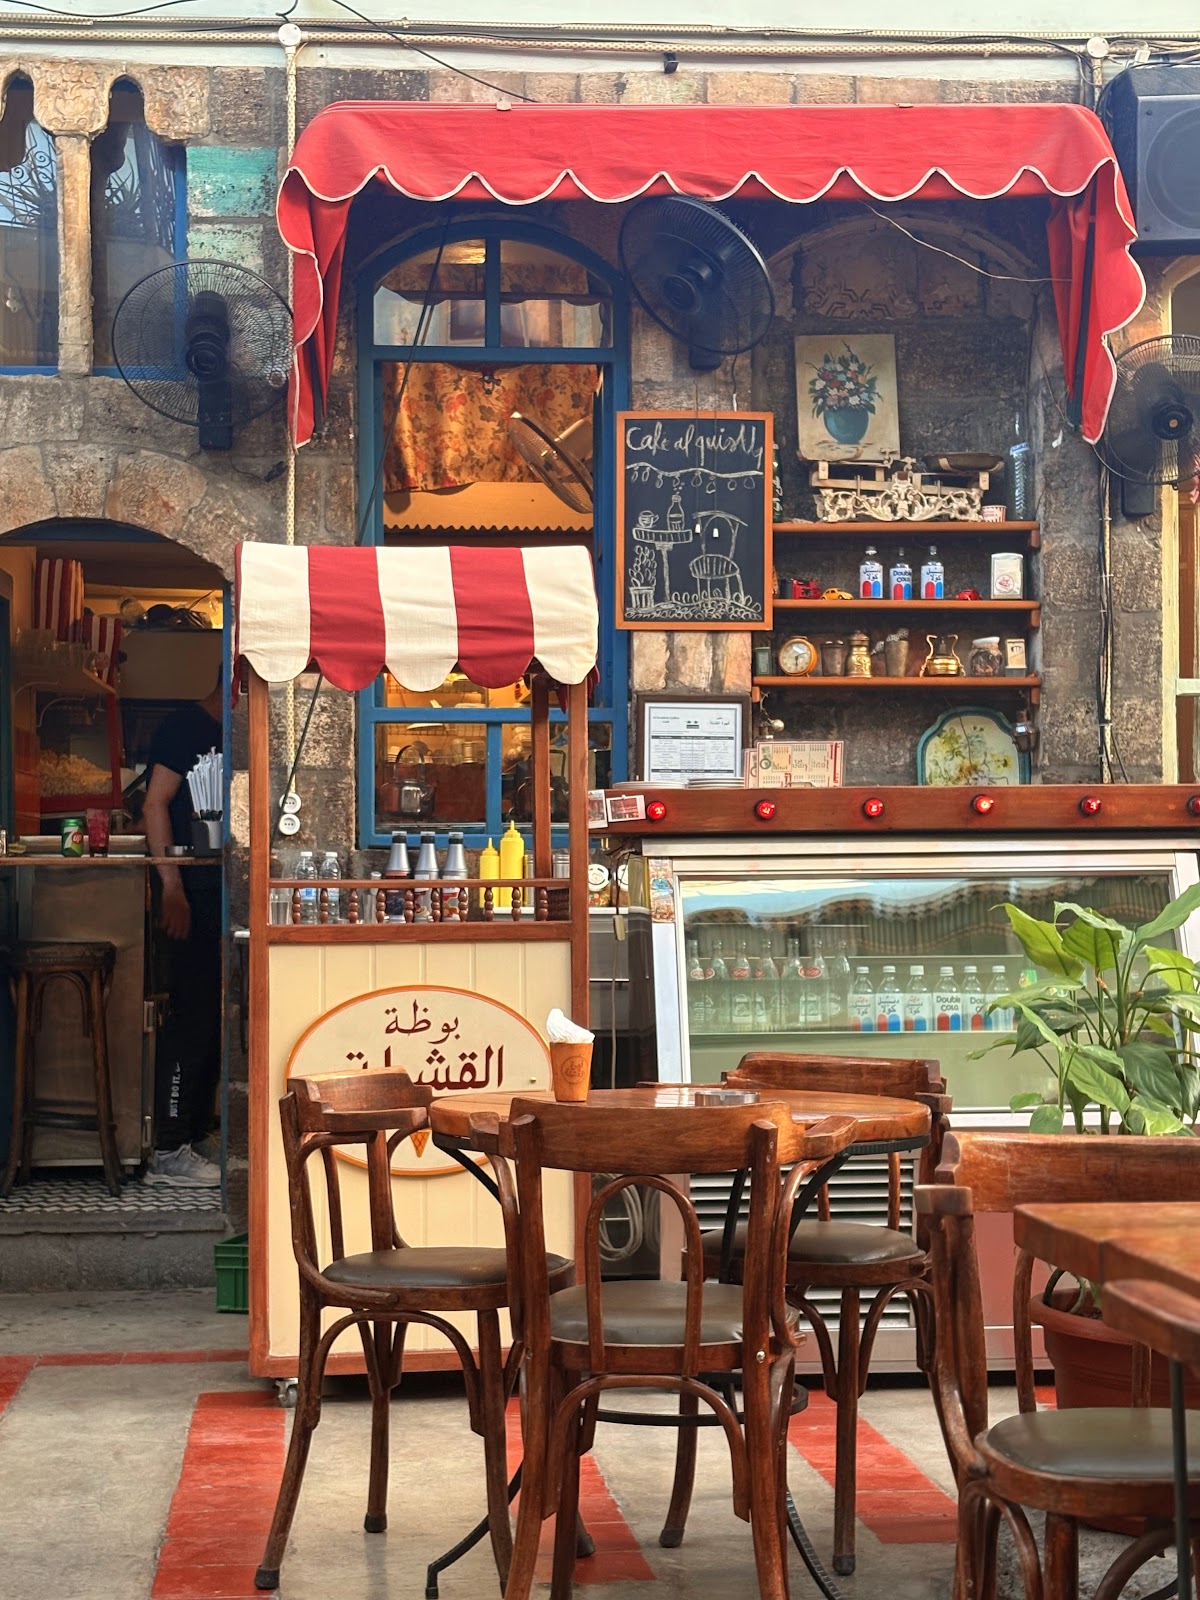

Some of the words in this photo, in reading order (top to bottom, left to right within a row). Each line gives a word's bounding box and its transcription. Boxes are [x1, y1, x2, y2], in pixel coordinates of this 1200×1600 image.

[385, 999, 460, 1044] بوظة
[171, 1085, 180, 1098] DO
[170, 1098, 178, 1117] JUST
